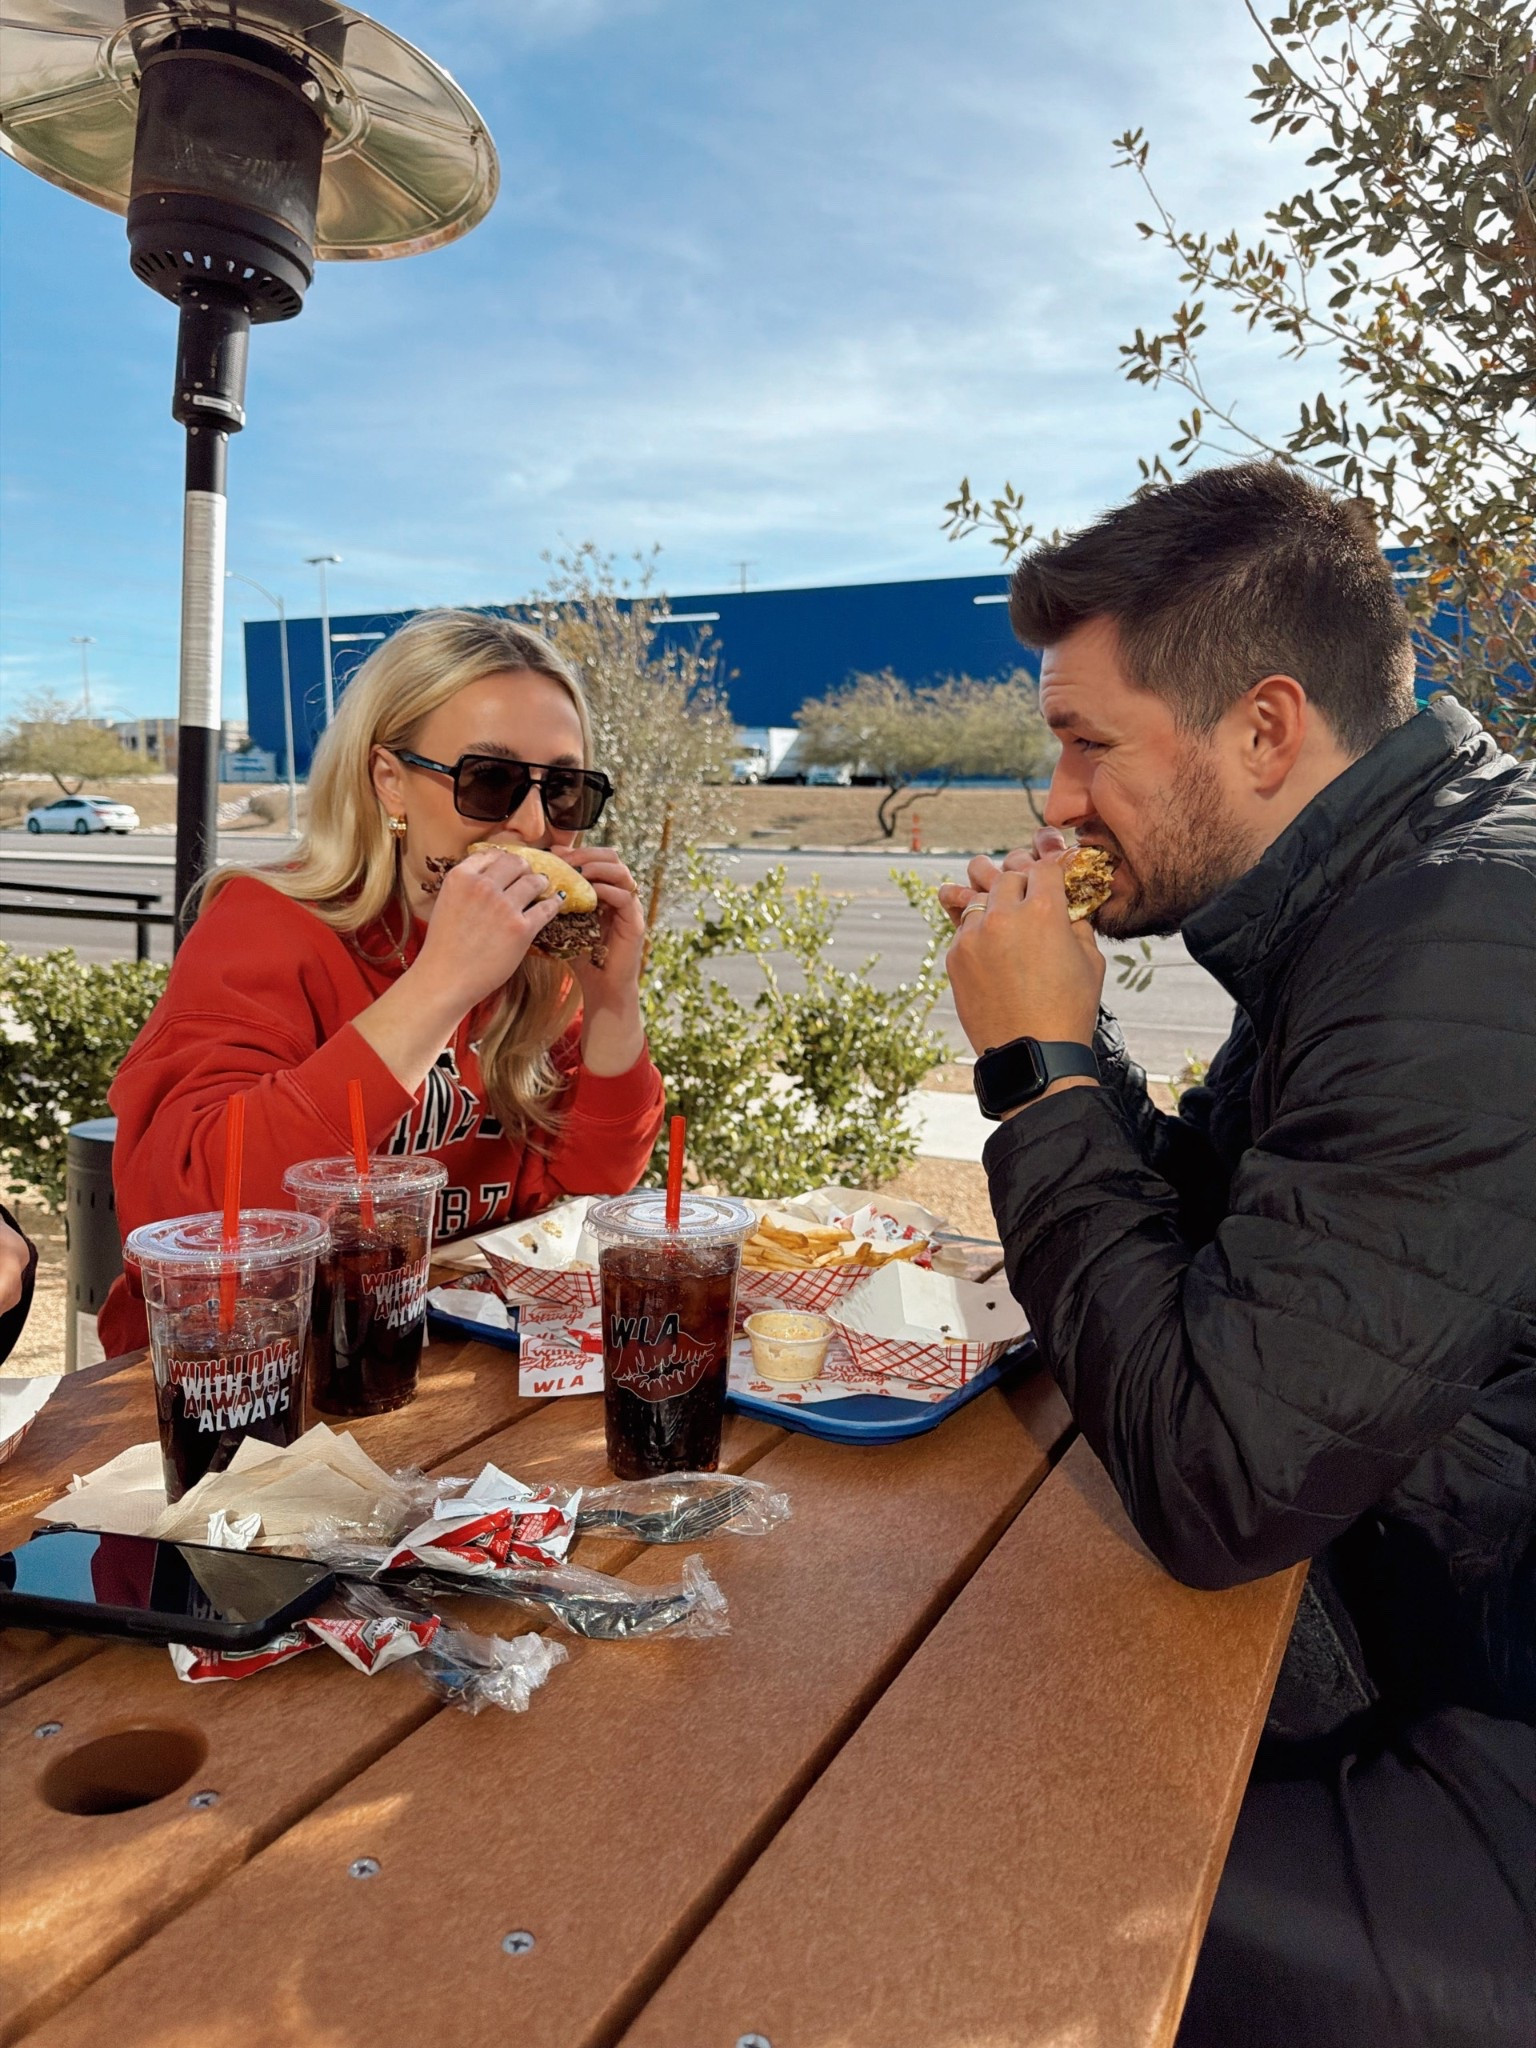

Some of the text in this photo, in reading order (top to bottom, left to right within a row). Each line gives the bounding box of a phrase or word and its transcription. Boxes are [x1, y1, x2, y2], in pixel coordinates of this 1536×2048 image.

[611, 1313, 680, 1348] WLA
[168, 1359, 227, 1385] WITH
[525, 1357, 594, 1372] Always
[182, 1372, 243, 1400] WITH
[534, 1375, 584, 1393] WLA
[198, 1386, 290, 1432] ALWAYS
